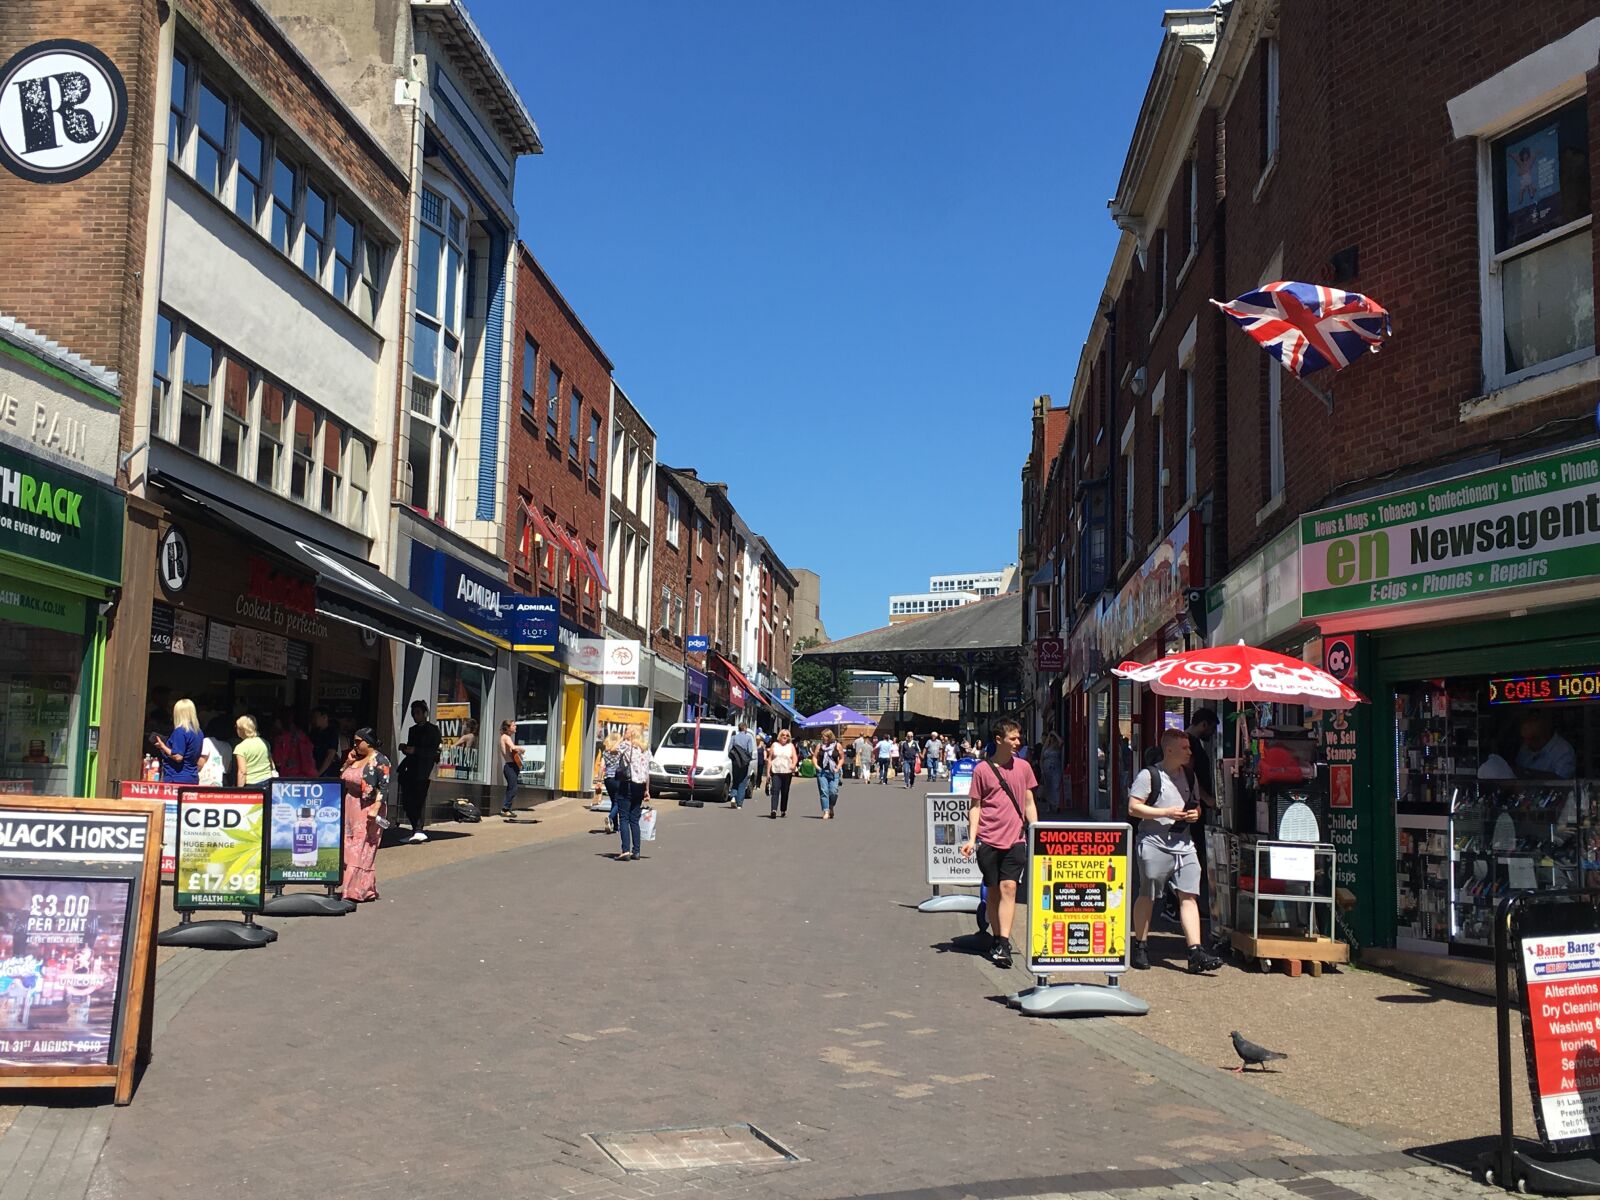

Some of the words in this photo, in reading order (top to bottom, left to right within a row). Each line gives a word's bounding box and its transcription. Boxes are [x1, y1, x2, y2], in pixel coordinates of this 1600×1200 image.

[12, 70, 103, 155] R
[1315, 520, 1337, 537] News
[1338, 518, 1345, 534] &
[1345, 512, 1369, 532] Mags
[1378, 501, 1418, 523] Tobacco
[1428, 482, 1499, 512] Confectionary
[1511, 470, 1548, 494] Drinks
[14, 522, 39, 537] EVERY
[40, 529, 61, 544] BODY
[1326, 530, 1390, 586] en
[1370, 581, 1408, 601] E-cigs
[1423, 571, 1473, 593] Phones
[1490, 557, 1548, 582] Repairs
[457, 573, 502, 618] ADMIRAL
[517, 604, 556, 612] ADMIRAL
[236, 594, 271, 621] Cooked
[274, 606, 284, 625] to
[286, 613, 328, 638] perfection
[1177, 677, 1228, 688] WALL'S
[1504, 680, 1551, 699] COILS
[1326, 732, 1338, 745] We
[1340, 731, 1356, 744] Sell
[1326, 747, 1357, 762] Stamps
[131, 783, 159, 794] NEW
[281, 784, 323, 798] KETO
[184, 808, 242, 828] CBD
[70, 825, 146, 850] HORSE
[1040, 831, 1092, 843] SMOKER
[1094, 832, 1121, 843] EXIT
[1330, 831, 1353, 844] Food
[207, 841, 235, 849] RANGE
[933, 846, 954, 855] Sale,
[1046, 844, 1078, 855] VAPE
[1080, 845, 1115, 855] SHOP
[1327, 848, 1358, 865] Sacks
[950, 867, 971, 875] Here
[188, 872, 257, 891] £17.99
[30, 894, 90, 917] £3.00
[191, 894, 246, 903] HEALTHRACK
[27, 918, 53, 931] PER
[57, 919, 88, 932] PINT
[1536, 944, 1566, 958] Bang
[1567, 941, 1596, 955] Bang
[1545, 982, 1599, 998] Alterations
[1542, 1004, 1560, 1019] Dry
[1563, 1000, 1600, 1015] Cleanin
[1549, 1020, 1594, 1034] Washing
[32, 1040, 74, 1053] AUGUST
[1561, 1038, 1597, 1052] Ironing
